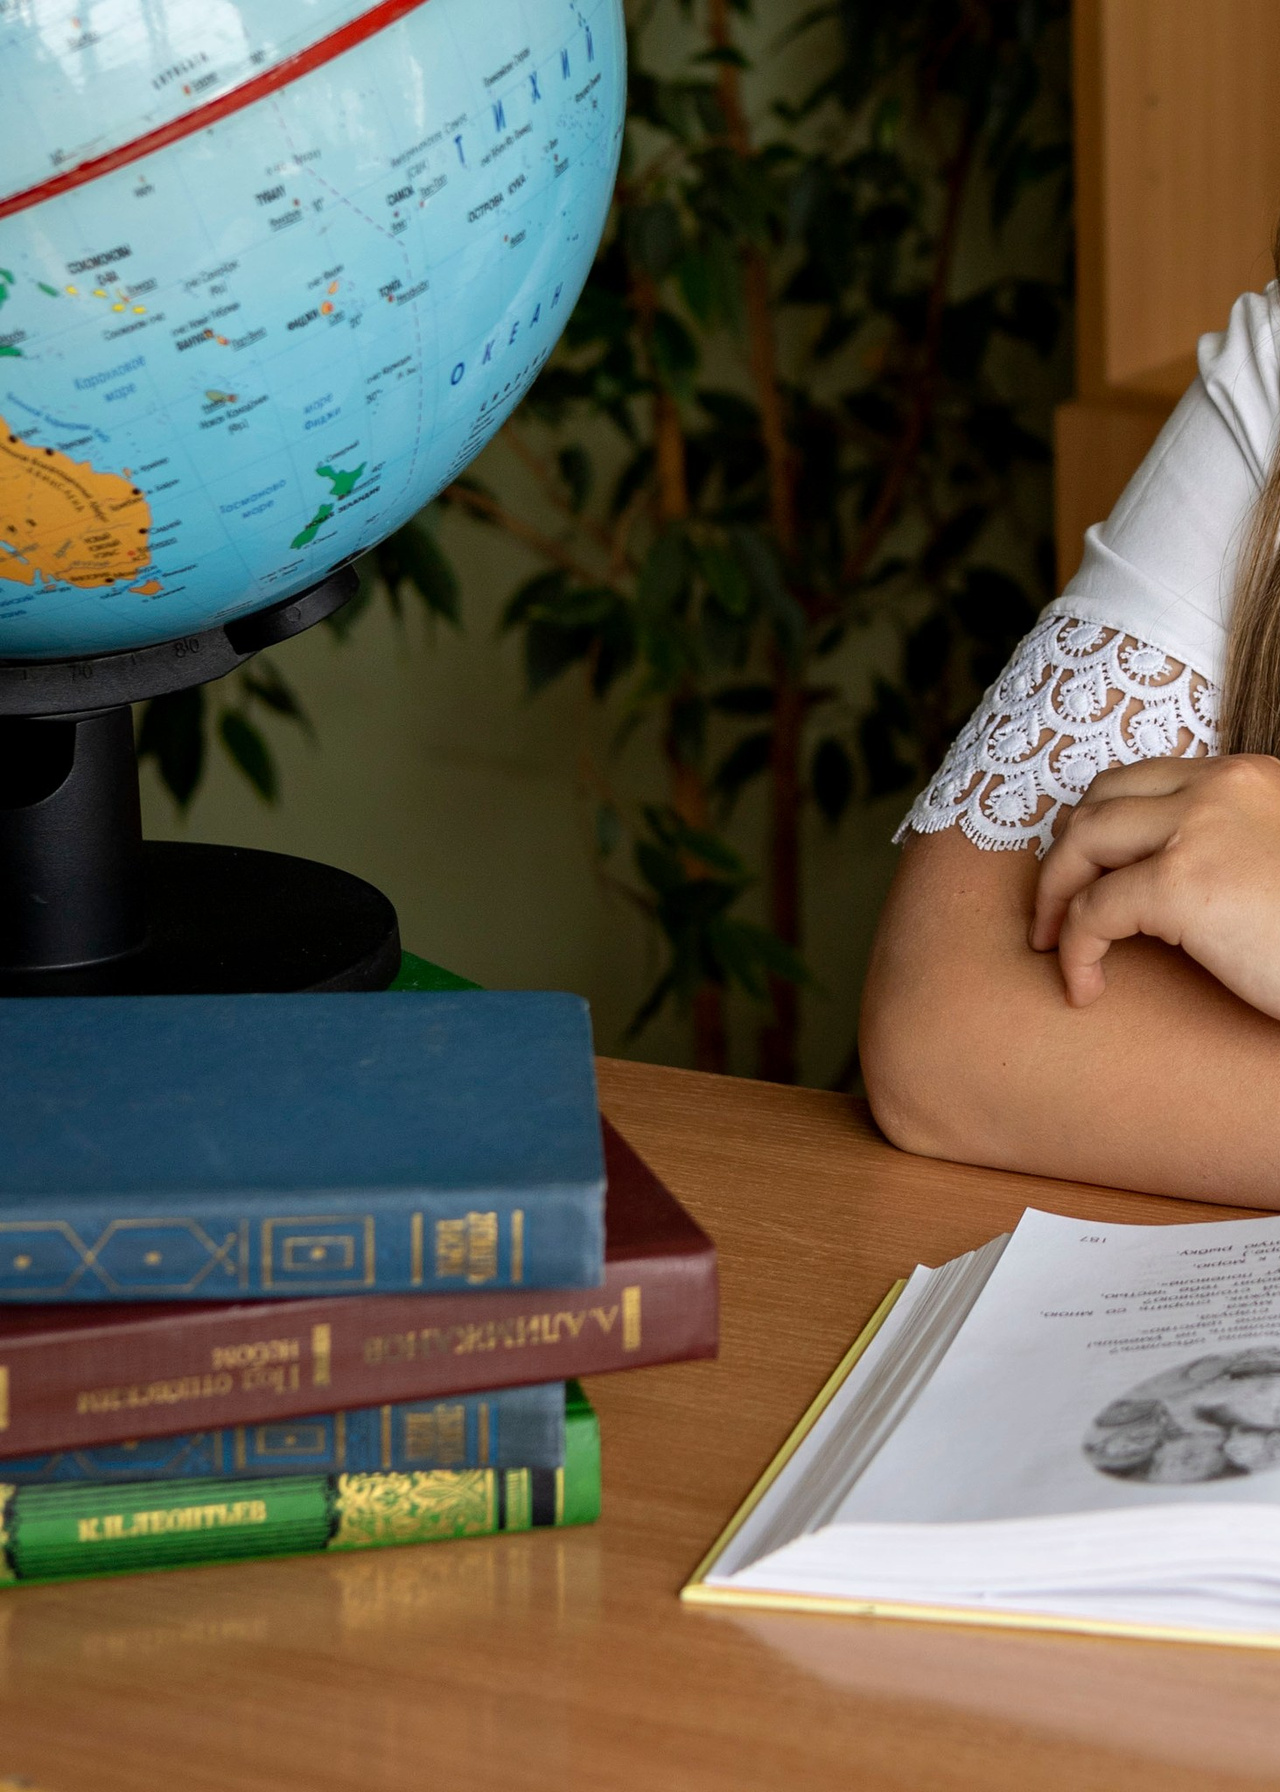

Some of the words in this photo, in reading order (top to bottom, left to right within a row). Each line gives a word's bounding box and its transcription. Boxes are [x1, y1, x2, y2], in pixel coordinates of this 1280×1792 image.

[450, 281, 564, 386] ОКЕАН
[173, 637, 201, 659] 80
[1079, 1236, 1107, 1244] 187
[1176, 1244, 1233, 1257] рыбку.
